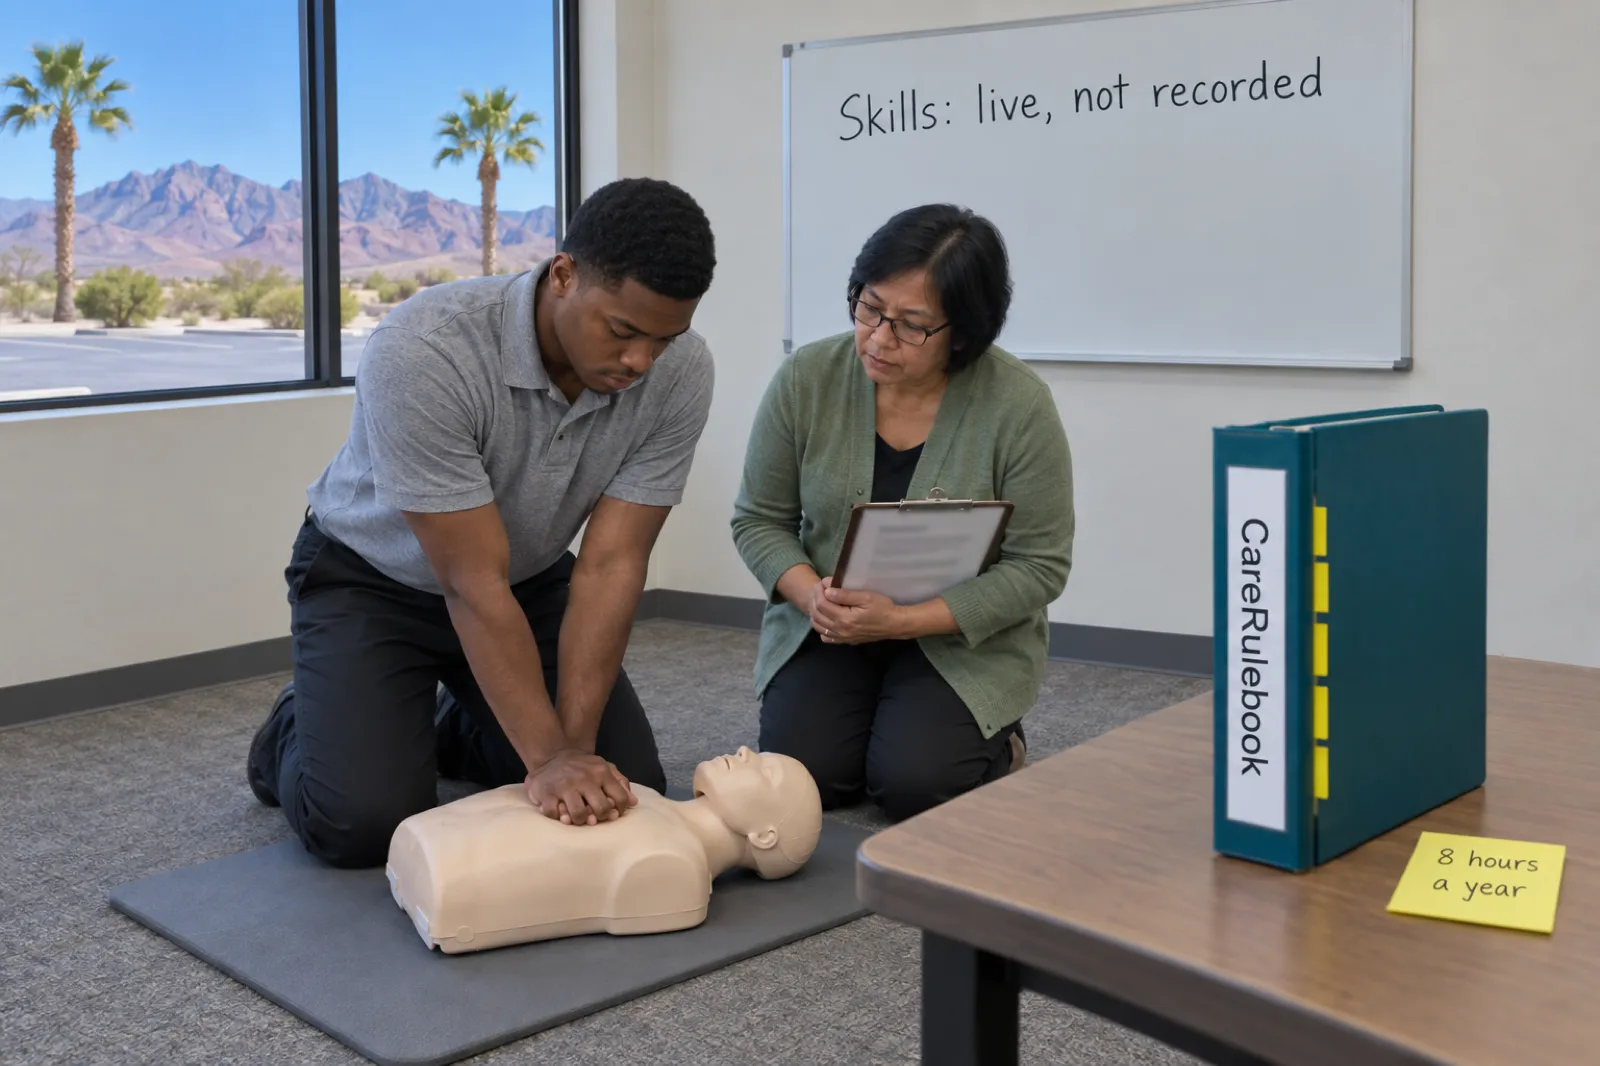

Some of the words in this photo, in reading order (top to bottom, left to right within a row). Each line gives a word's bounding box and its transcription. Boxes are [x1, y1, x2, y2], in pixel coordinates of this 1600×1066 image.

[839, 88, 952, 141] Skills:
[978, 83, 1052, 125] live,
[1074, 73, 1130, 113] not
[1152, 55, 1323, 108] recorded
[1241, 518, 1269, 777] CareRulebook
[1437, 848, 1455, 866] 8
[1468, 850, 1539, 873] hours
[1432, 878, 1449, 892] a
[1462, 880, 1527, 902] year
